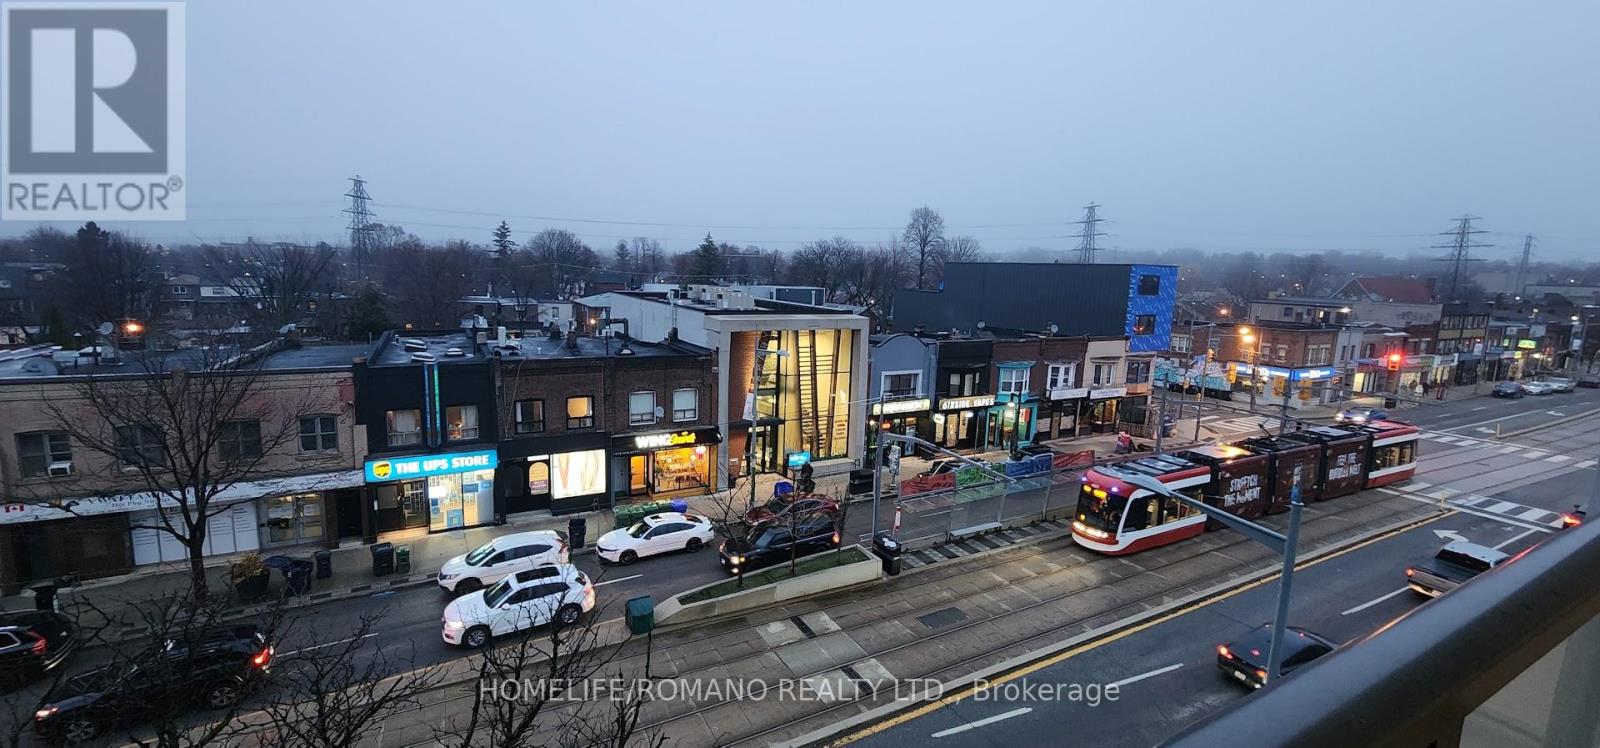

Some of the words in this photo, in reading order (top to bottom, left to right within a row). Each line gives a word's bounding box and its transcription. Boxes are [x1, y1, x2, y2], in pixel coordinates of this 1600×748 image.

[395, 461, 421, 475] THE
[423, 458, 449, 472] UPS
[451, 454, 490, 469] STORE
[1223, 492, 1236, 508] THE
